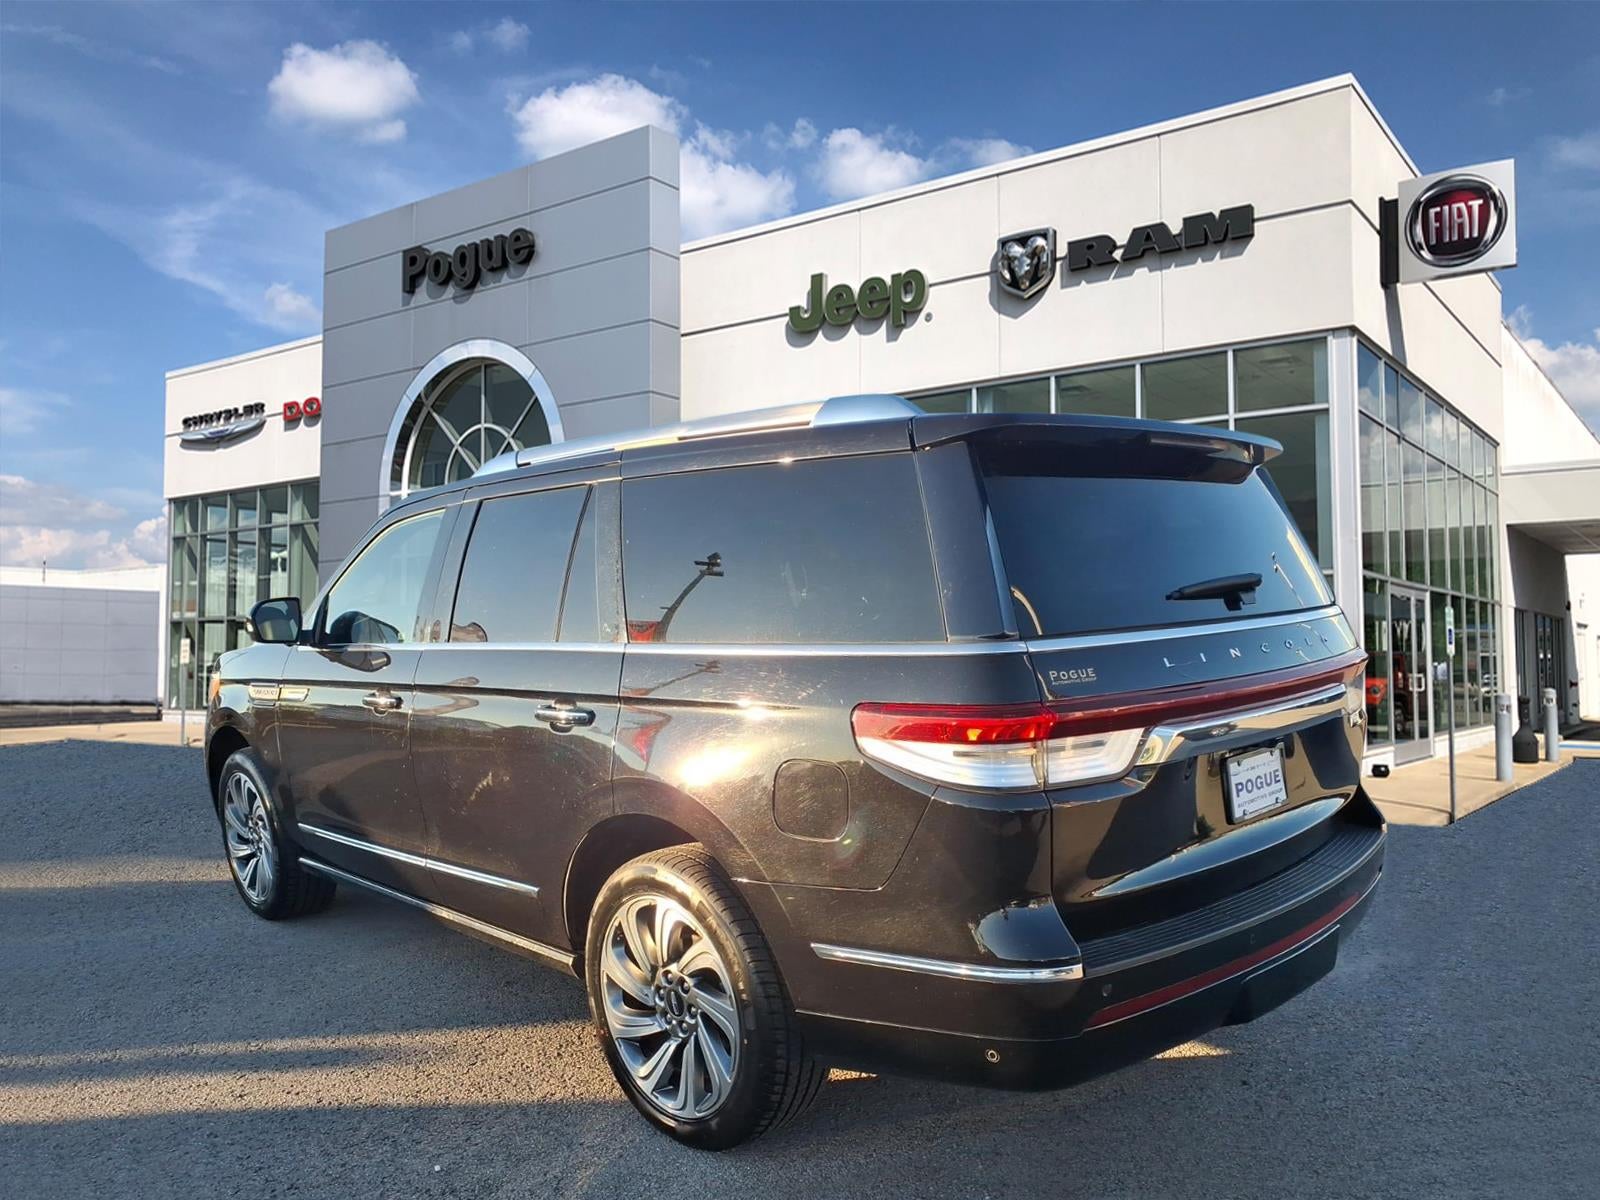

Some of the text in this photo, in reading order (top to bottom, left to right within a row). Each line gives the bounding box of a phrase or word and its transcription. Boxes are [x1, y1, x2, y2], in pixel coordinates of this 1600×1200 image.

[1067, 204, 1254, 272] RAM
[1428, 199, 1484, 246] FIAT
[401, 227, 536, 294] Pogue
[789, 268, 927, 333] Jeep
[182, 402, 266, 428] CHRYSLER
[1049, 667, 1096, 681] POGUE
[1235, 769, 1281, 798] POGUE
